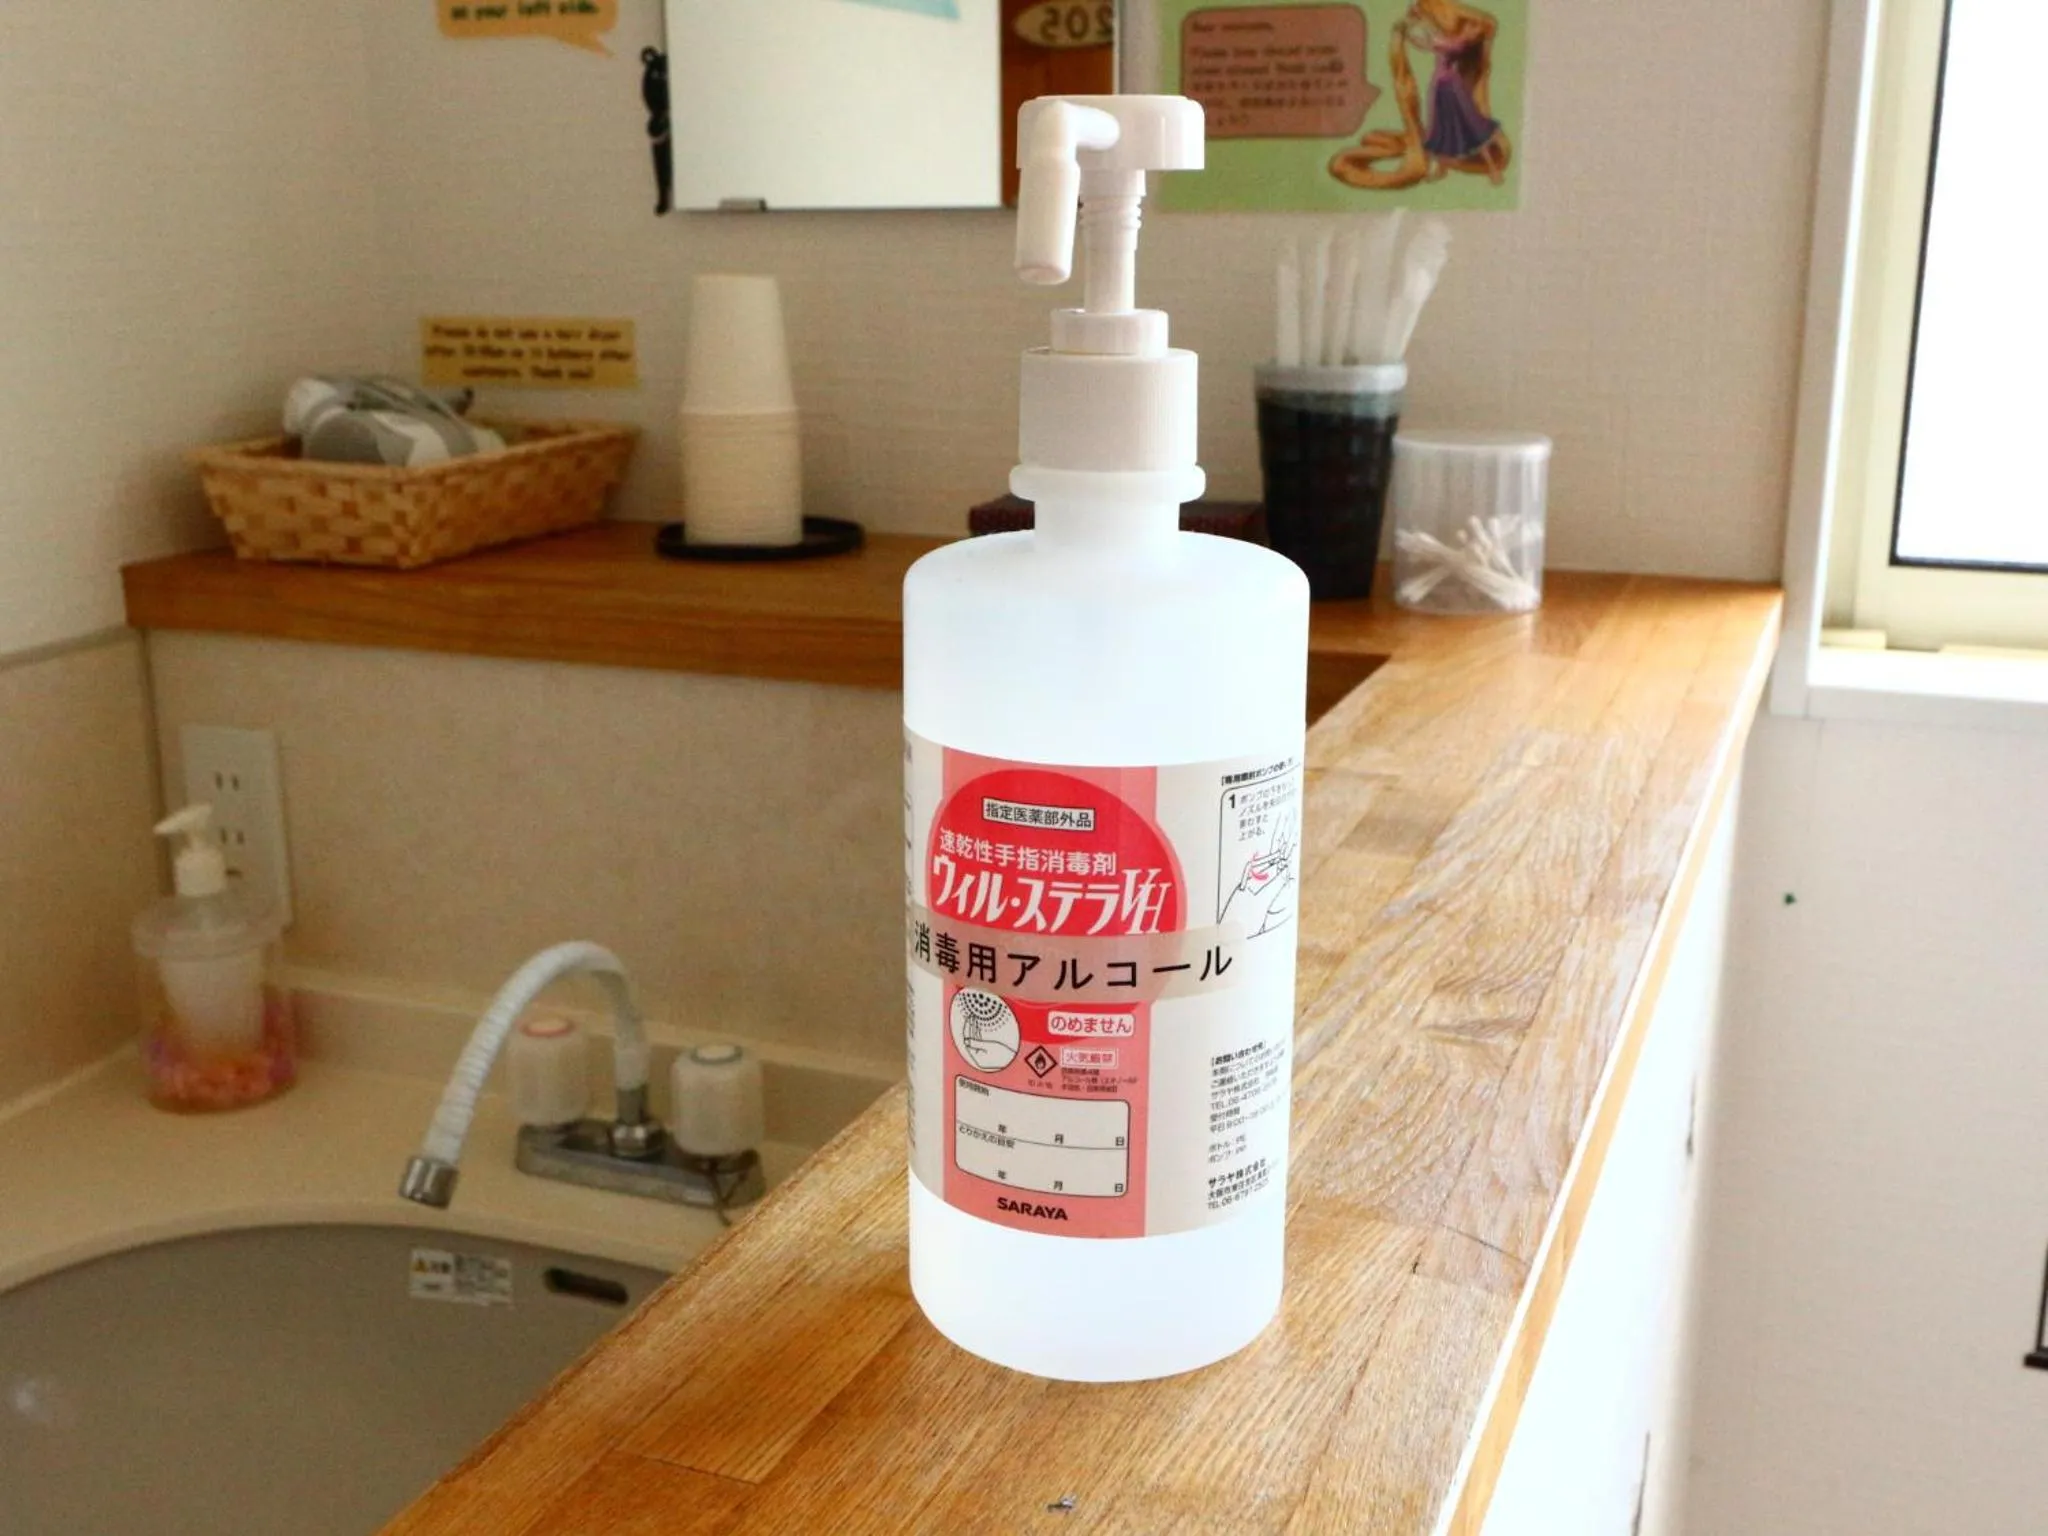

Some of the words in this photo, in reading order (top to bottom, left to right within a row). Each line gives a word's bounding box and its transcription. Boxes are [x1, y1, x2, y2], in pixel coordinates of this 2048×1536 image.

[1229, 793, 1236, 808] 1
[985, 801, 1093, 829] 指定医薬部外品
[938, 827, 1118, 876] 速乾性手指消毒剤
[914, 920, 1233, 992] 消毒用アルコール
[1050, 1015, 1132, 1034] のめません
[1054, 1133, 1064, 1145] 月
[1115, 1136, 1125, 1147] 日
[1053, 1180, 1063, 1191] 月
[1114, 1182, 1124, 1193] 日
[996, 1196, 1069, 1221] SARAYA
